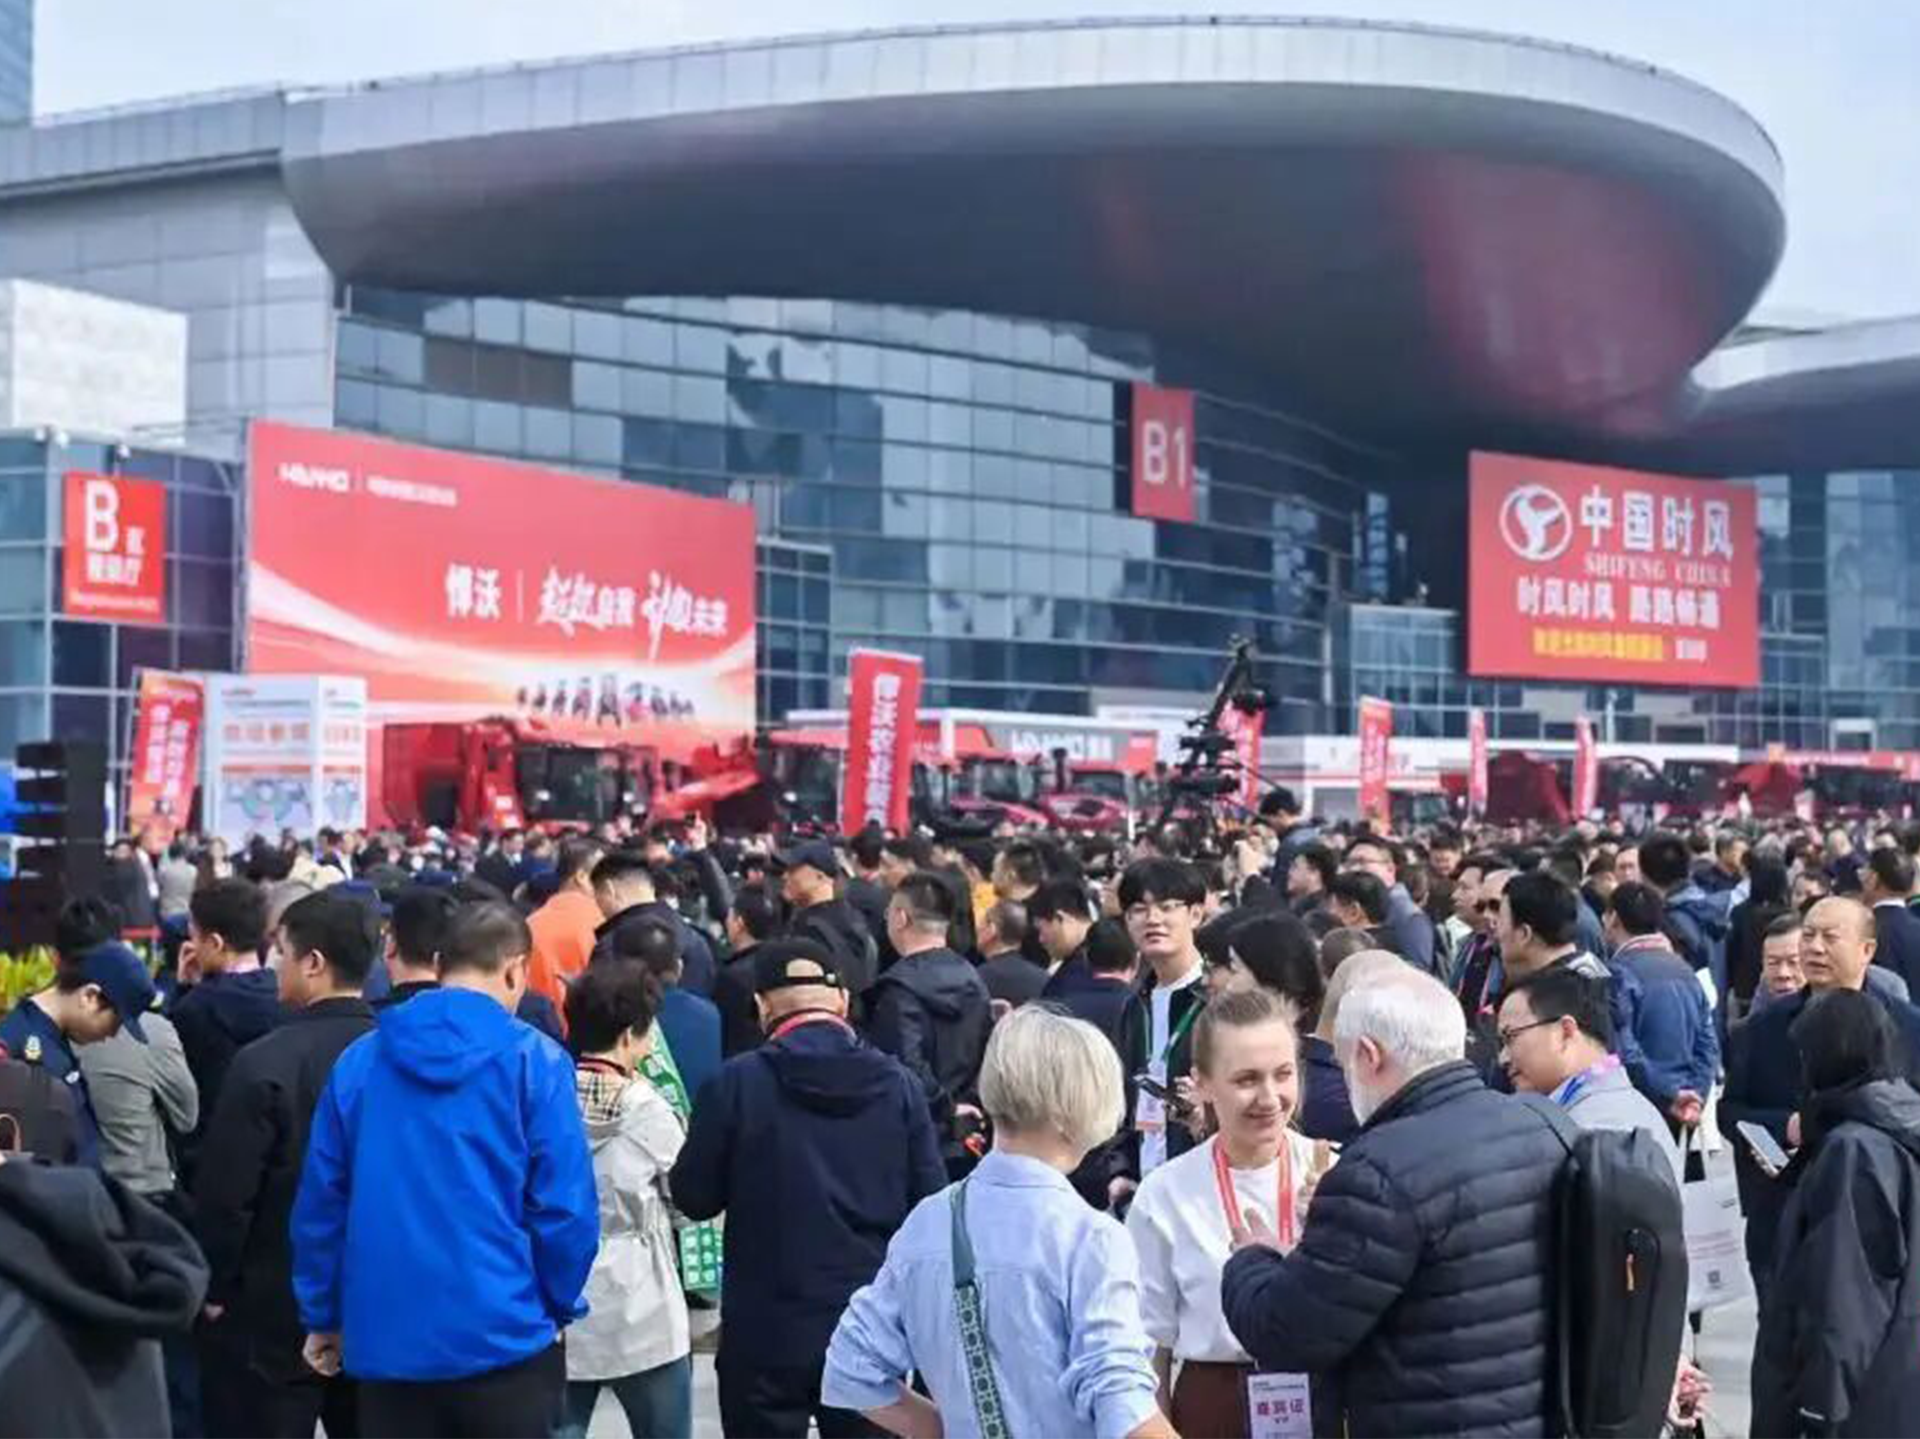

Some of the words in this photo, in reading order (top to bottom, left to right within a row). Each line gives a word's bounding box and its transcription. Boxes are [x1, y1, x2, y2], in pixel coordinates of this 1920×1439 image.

[1142, 420, 1187, 489] B1
[84, 479, 119, 552] B
[1579, 484, 1734, 561] 中国时风
[1516, 575, 1615, 621] 时风时风
[1584, 550, 1667, 581] SHIFENG
